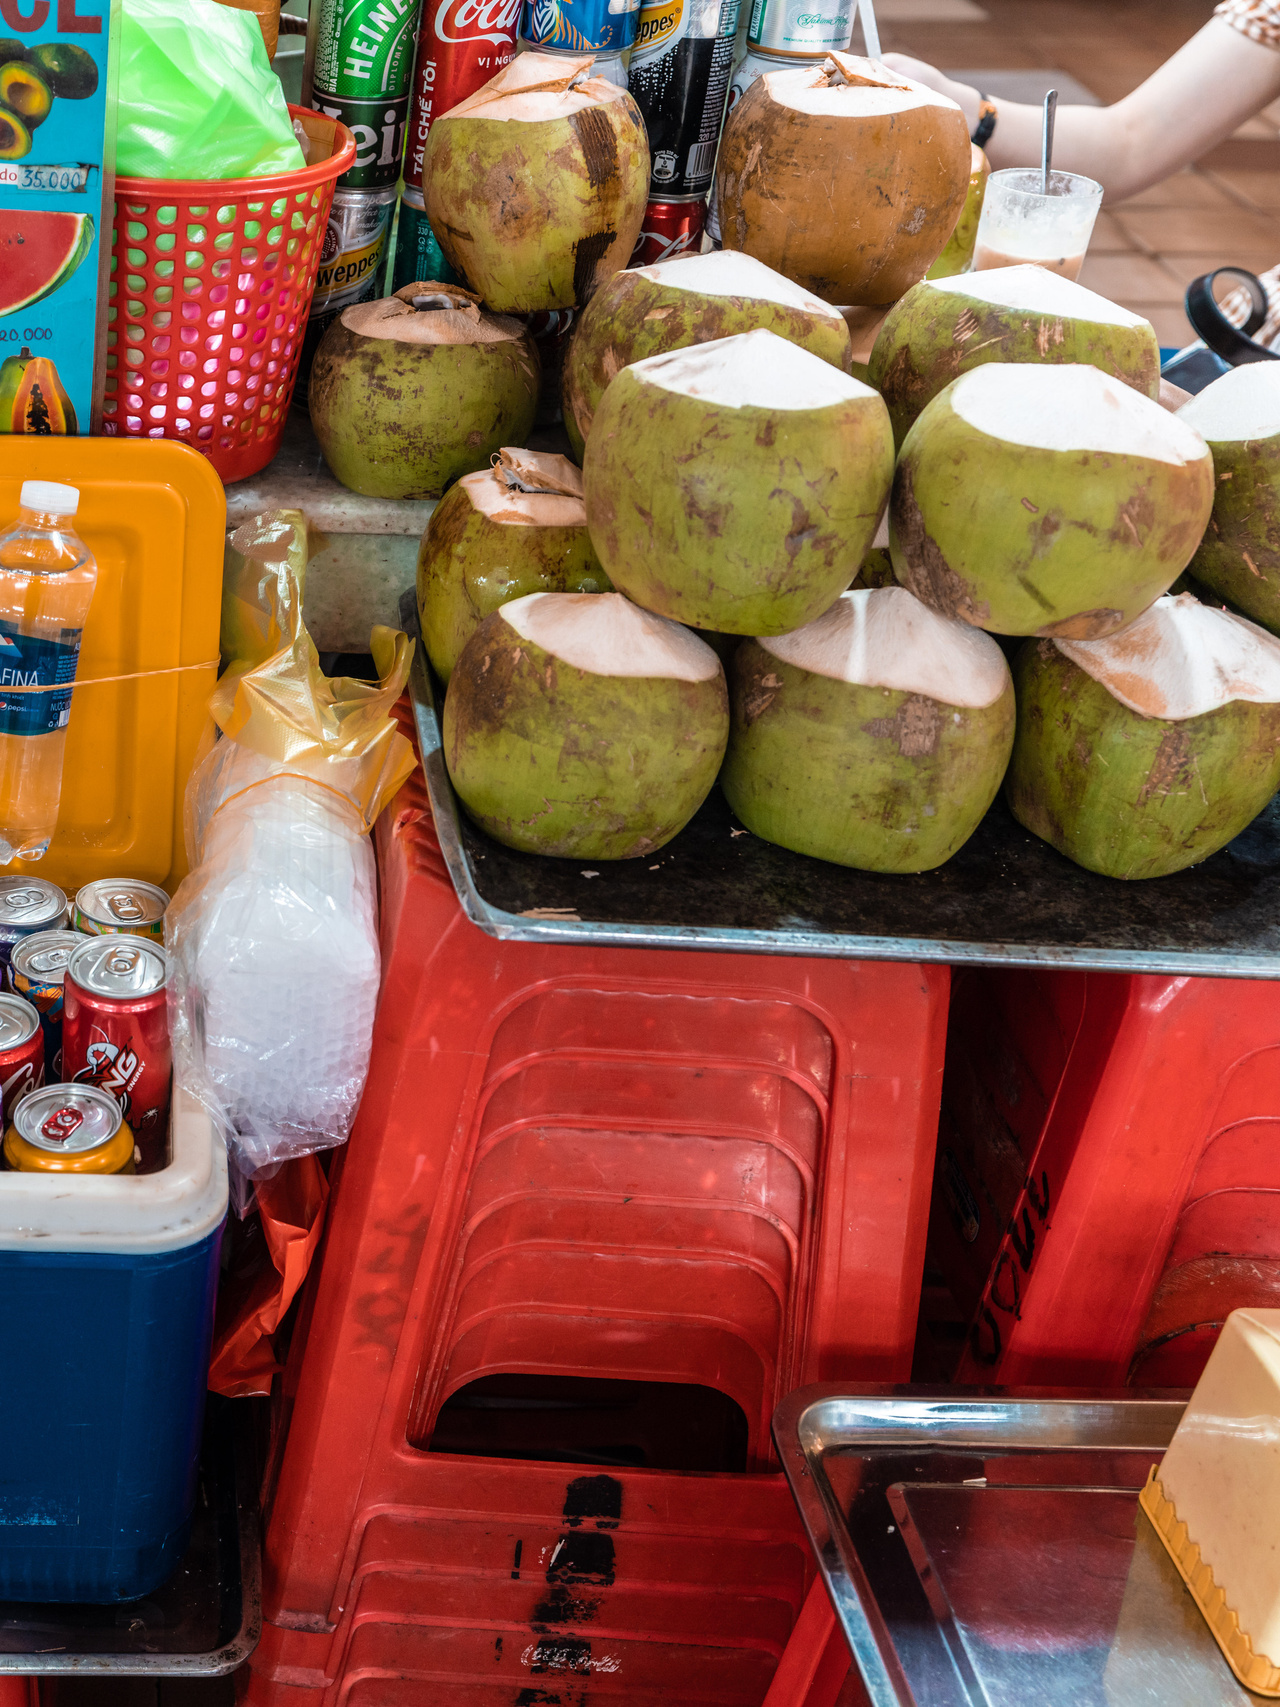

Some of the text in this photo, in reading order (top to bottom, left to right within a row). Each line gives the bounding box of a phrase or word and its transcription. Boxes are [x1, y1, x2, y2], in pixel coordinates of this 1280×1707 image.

[389, 45, 403, 91] DIPLOME
[422, 60, 437, 92] TÔI
[478, 57, 490, 68] VỊ
[21, 169, 81, 190] 35.000
[126, 1060, 146, 1092] ENERGY
